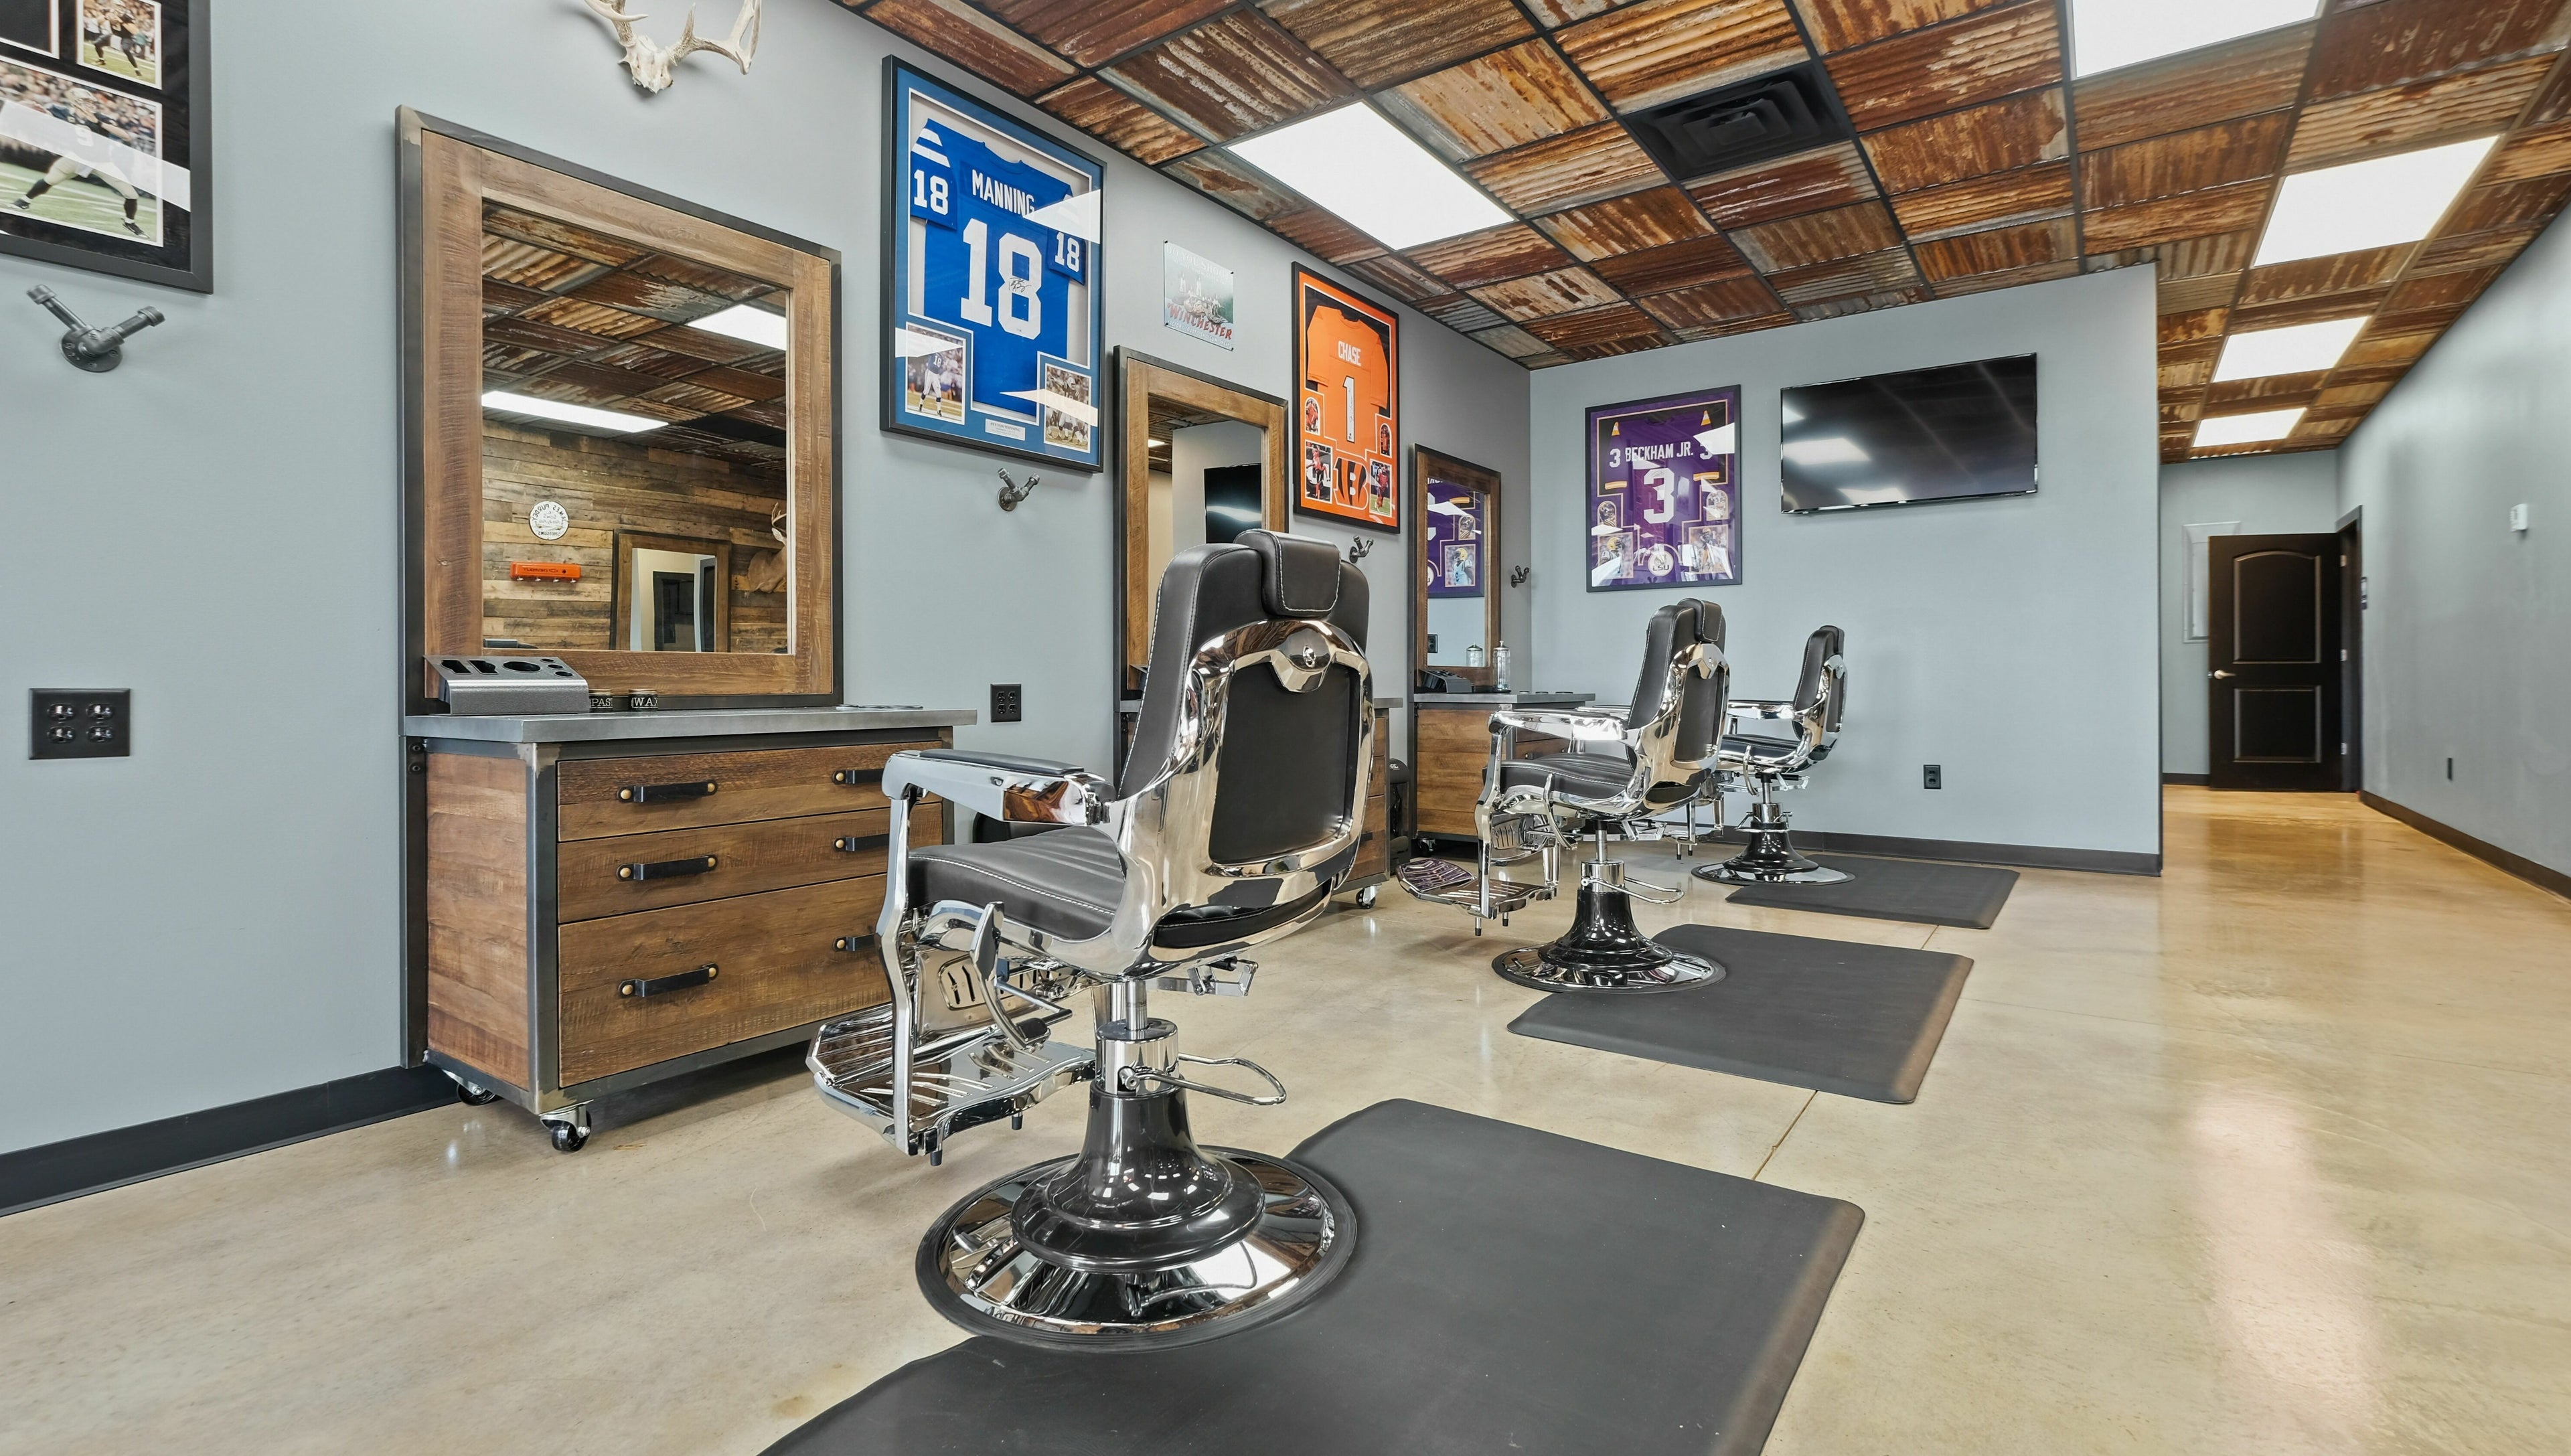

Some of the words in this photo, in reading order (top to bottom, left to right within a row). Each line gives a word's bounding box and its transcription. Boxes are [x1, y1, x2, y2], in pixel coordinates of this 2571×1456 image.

[914, 169, 948, 216] 18
[971, 169, 1035, 217] MANNING
[1055, 232, 1080, 272] 18
[961, 218, 1042, 340] 18
[1167, 303, 1233, 340] WINCHESTER
[933, 355, 942, 368] 18
[1338, 341, 1361, 367] CHASE
[1342, 375, 1355, 444] 1
[1609, 448, 1621, 468] 3
[1625, 443, 1674, 462] BECKHAM
[1677, 441, 1694, 457] JR.
[1644, 467, 1674, 524] 3
